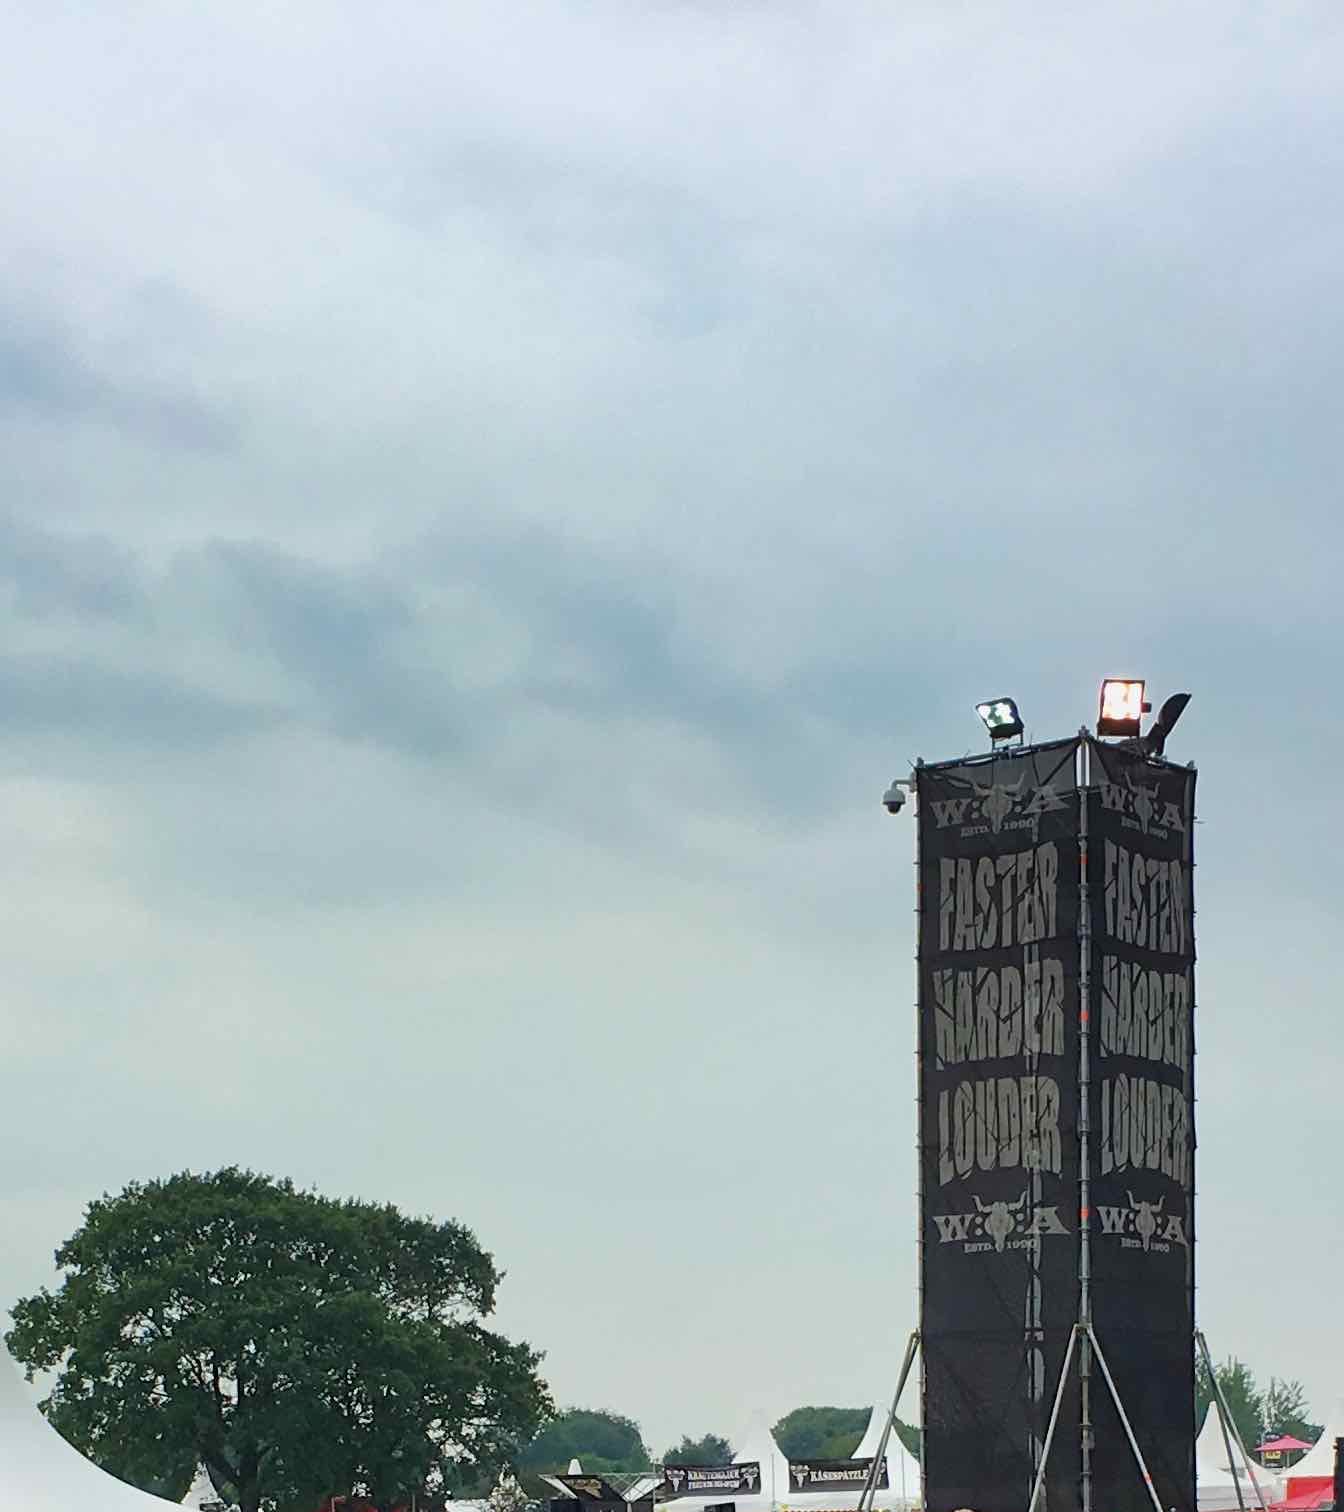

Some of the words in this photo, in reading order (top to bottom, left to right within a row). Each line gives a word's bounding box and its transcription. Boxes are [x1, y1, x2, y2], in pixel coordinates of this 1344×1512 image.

[939, 841, 1058, 951] FASTER
[1105, 838, 1184, 955] FASTER
[933, 959, 1065, 1071] HARDER
[1099, 955, 1188, 1074] HARDER
[939, 1076, 1062, 1186] LOUDER
[1101, 1073, 1189, 1191] LOUDER
